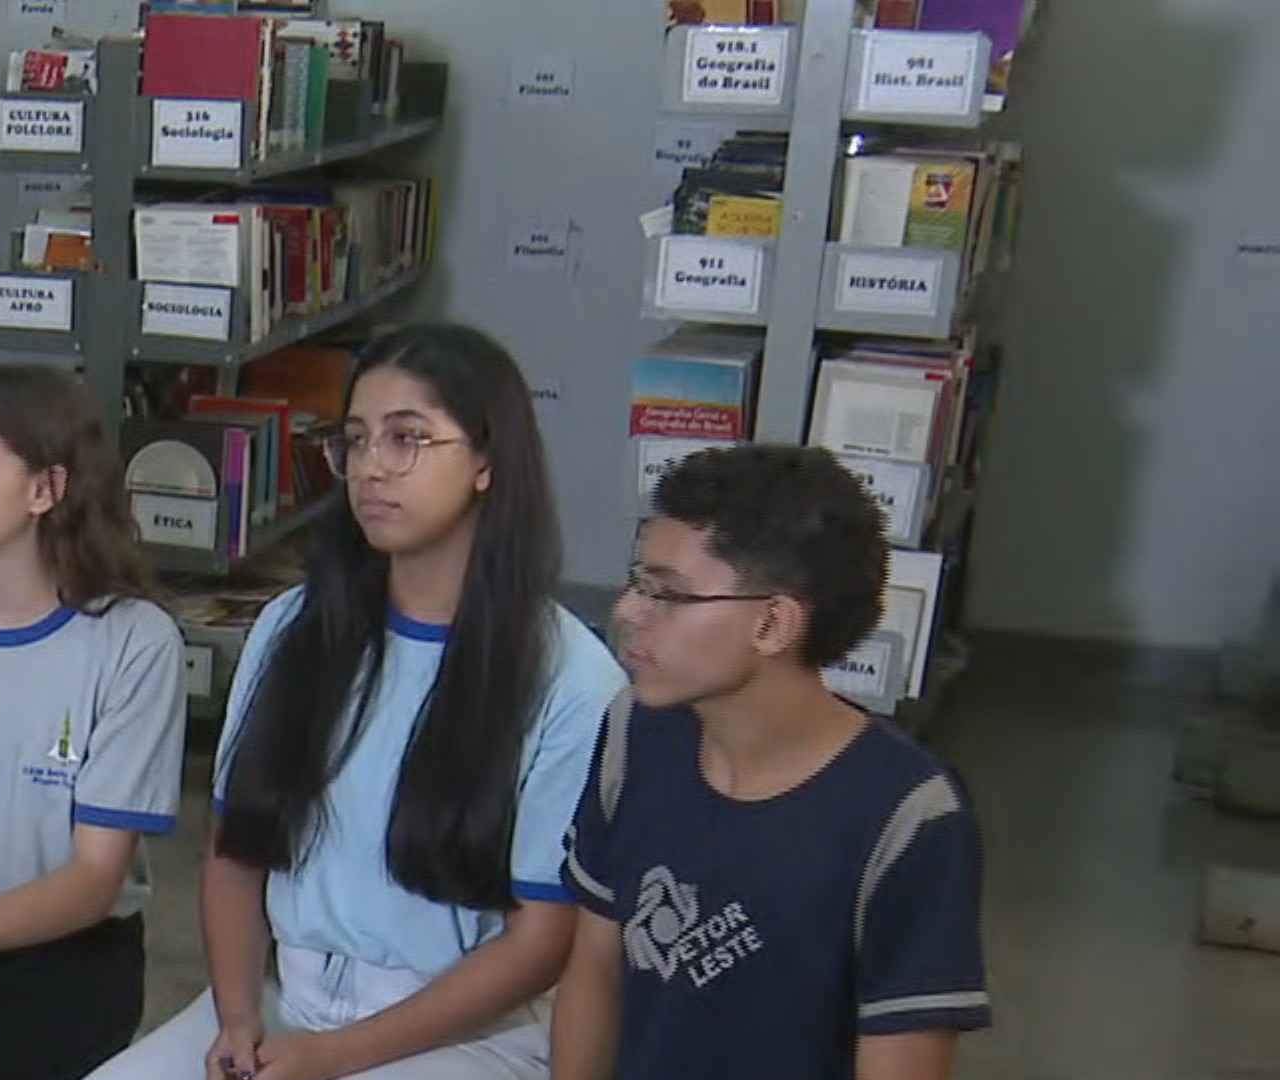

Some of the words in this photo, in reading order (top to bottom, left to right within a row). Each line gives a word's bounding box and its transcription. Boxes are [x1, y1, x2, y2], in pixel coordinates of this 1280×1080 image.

[716, 40, 758, 53] 918.1
[696, 56, 776, 73] Geografia
[697, 76, 718, 89] do
[722, 76, 770, 90] Brasil
[874, 72, 911, 86] Hist.
[916, 73, 964, 87] Brasil
[9, 110, 71, 122] CULTURA
[6, 123, 72, 136] FOLCLORE
[161, 125, 234, 142] Sociologia
[699, 257, 724, 270] 911
[674, 270, 747, 287] Geografia
[849, 274, 927, 292] HISTÓRIA
[9, 300, 43, 313] AFRO
[147, 301, 223, 318] SOCIOLOGIA
[687, 925, 766, 988] LESTE
